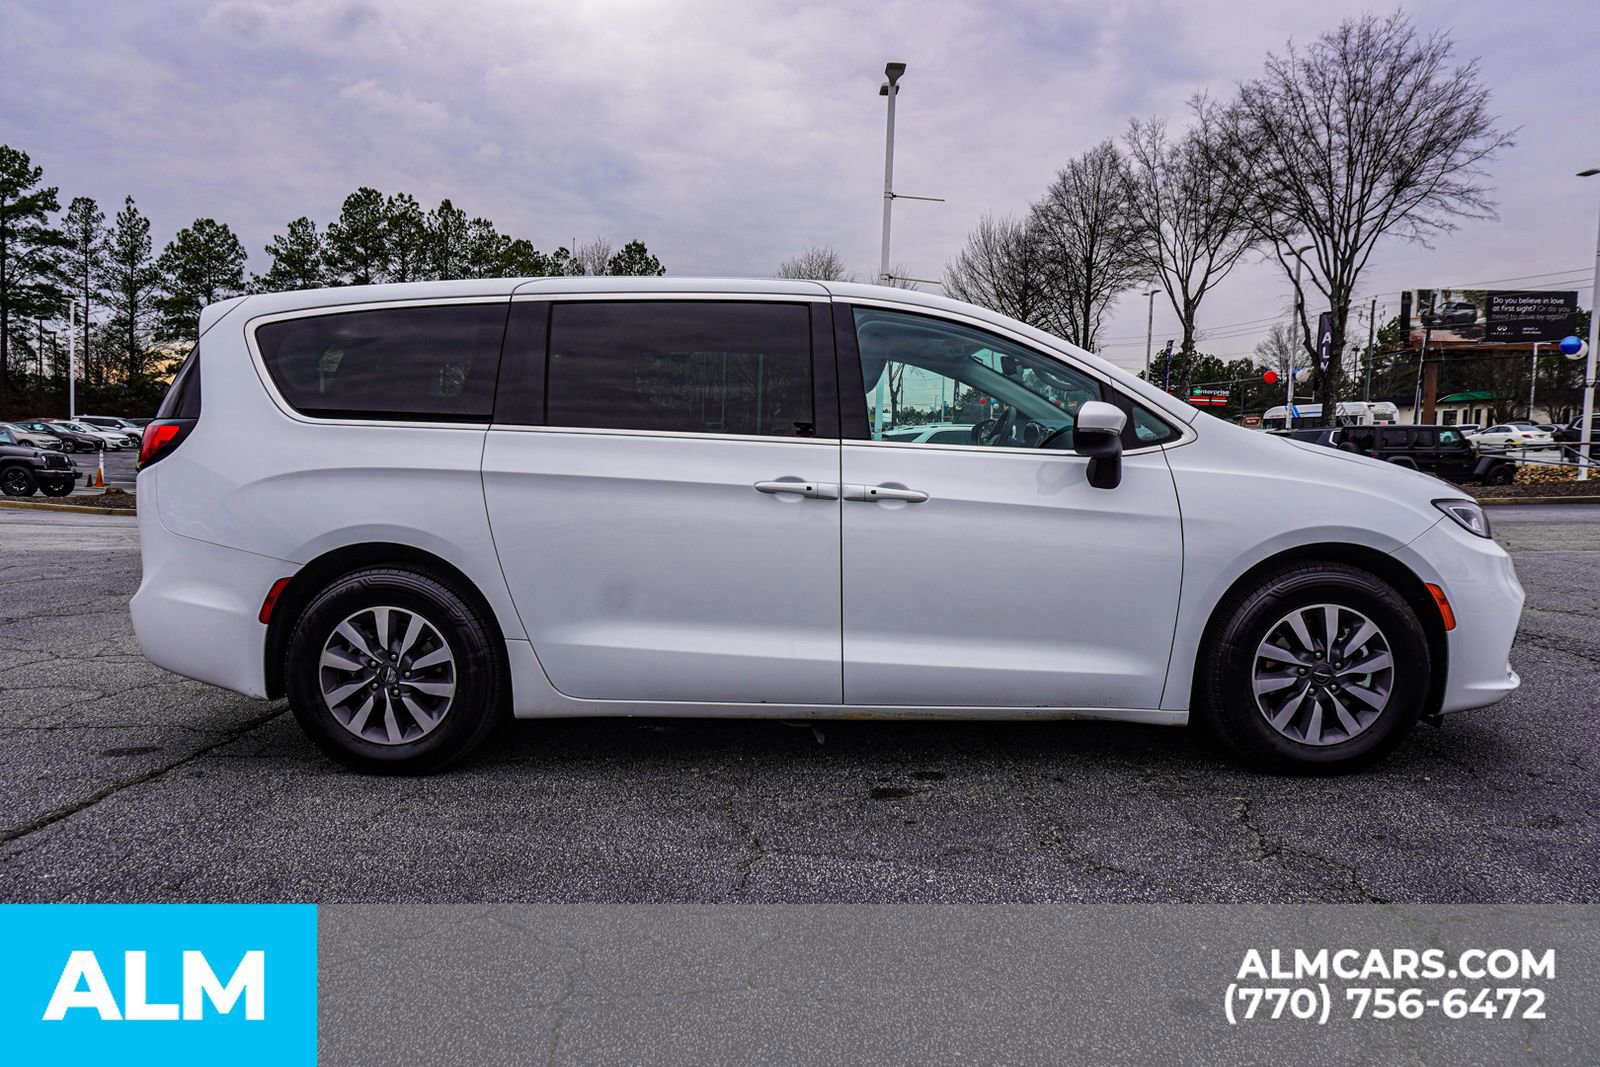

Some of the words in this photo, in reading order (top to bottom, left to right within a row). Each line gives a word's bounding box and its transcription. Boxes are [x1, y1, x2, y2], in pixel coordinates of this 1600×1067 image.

[1493, 296, 1503, 304] Do
[1518, 296, 1541, 304] believe
[1516, 305, 1537, 313] sight?
